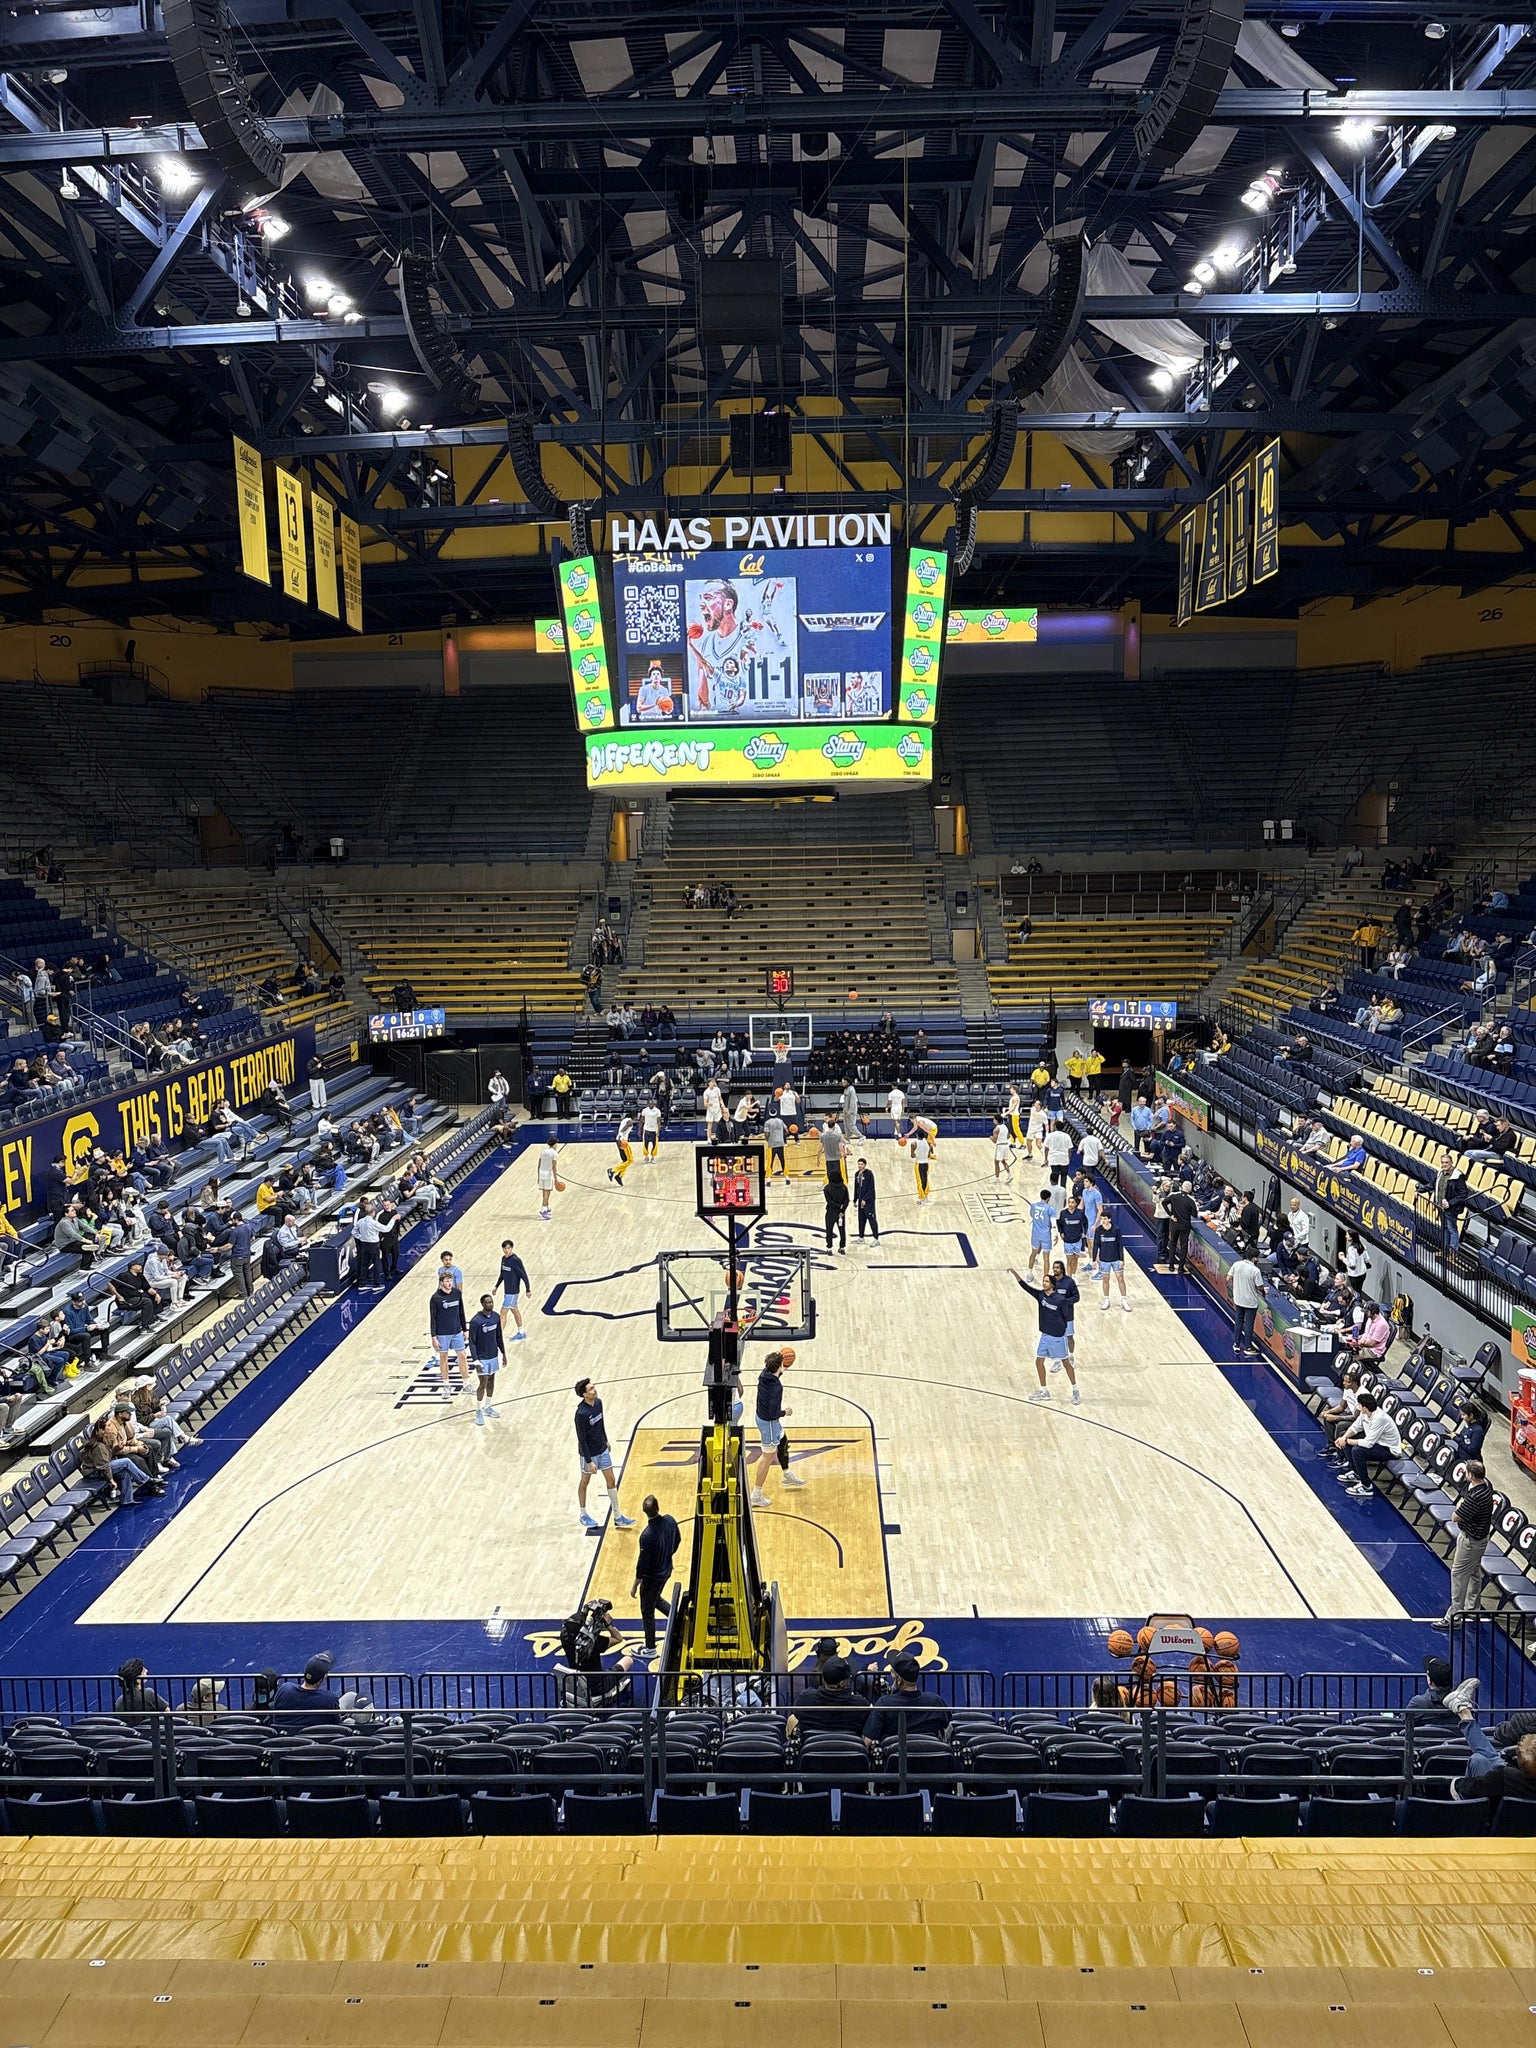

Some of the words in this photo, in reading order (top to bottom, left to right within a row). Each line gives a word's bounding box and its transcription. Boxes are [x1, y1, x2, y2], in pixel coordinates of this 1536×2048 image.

[1260, 467, 1274, 518] 40
[285, 492, 298, 541] 13
[1237, 491, 1244, 537] 11
[612, 517, 713, 551] HAAS
[725, 513, 891, 549] PAVILION
[1211, 511, 1218, 554] 5
[628, 562, 684, 574] #GoBears
[739, 553, 765, 576] Cal
[981, 614, 1010, 631] Starry
[1481, 608, 1504, 622] 26
[49, 634, 72, 648] 20
[388, 634, 403, 647] 21
[748, 657, 792, 699] 11-1
[724, 689, 733, 699] 10
[743, 735, 789, 763] Starry
[822, 734, 868, 761] Starry
[896, 734, 924, 761] Starry
[590, 740, 715, 780] DIFFERENT
[773, 978, 788, 992] 30
[1091, 1000, 1107, 1013] Cal
[1113, 1003, 1120, 1012] 0
[1130, 1006, 1135, 1014] 1
[1145, 1004, 1151, 1013] 0
[371, 1015, 385, 1029] Cal
[391, 1016, 397, 1025] 0
[418, 1013, 424, 1022] 0
[1118, 1017, 1146, 1027] 16:21
[1166, 1022, 1172, 1030] 0
[396, 1028, 420, 1039] 16:21
[437, 1028, 442, 1036] 0
[118, 1089, 162, 1158] THIS
[166, 1081, 184, 1140] IS
[187, 1065, 226, 1125] BEAR
[230, 1038, 295, 1109] TERRITORY
[0, 1135, 33, 1214] EY
[1316, 1171, 1329, 1197] Cal
[714, 1175, 750, 1207] 30
[981, 1192, 1025, 1223] HAAS
[1034, 1210, 1045, 1220] 24
[1361, 1200, 1375, 1229] Cal
[1382, 1395, 1394, 1413] G
[1395, 1408, 1408, 1426] G
[1408, 1421, 1422, 1440] G
[1422, 1433, 1437, 1452] G
[1436, 1447, 1450, 1466] G
[1452, 1462, 1467, 1482] G
[1502, 1510, 1519, 1532] G
[1519, 1527, 1536, 1549] G
[1161, 1635, 1194, 1644] Wilson
